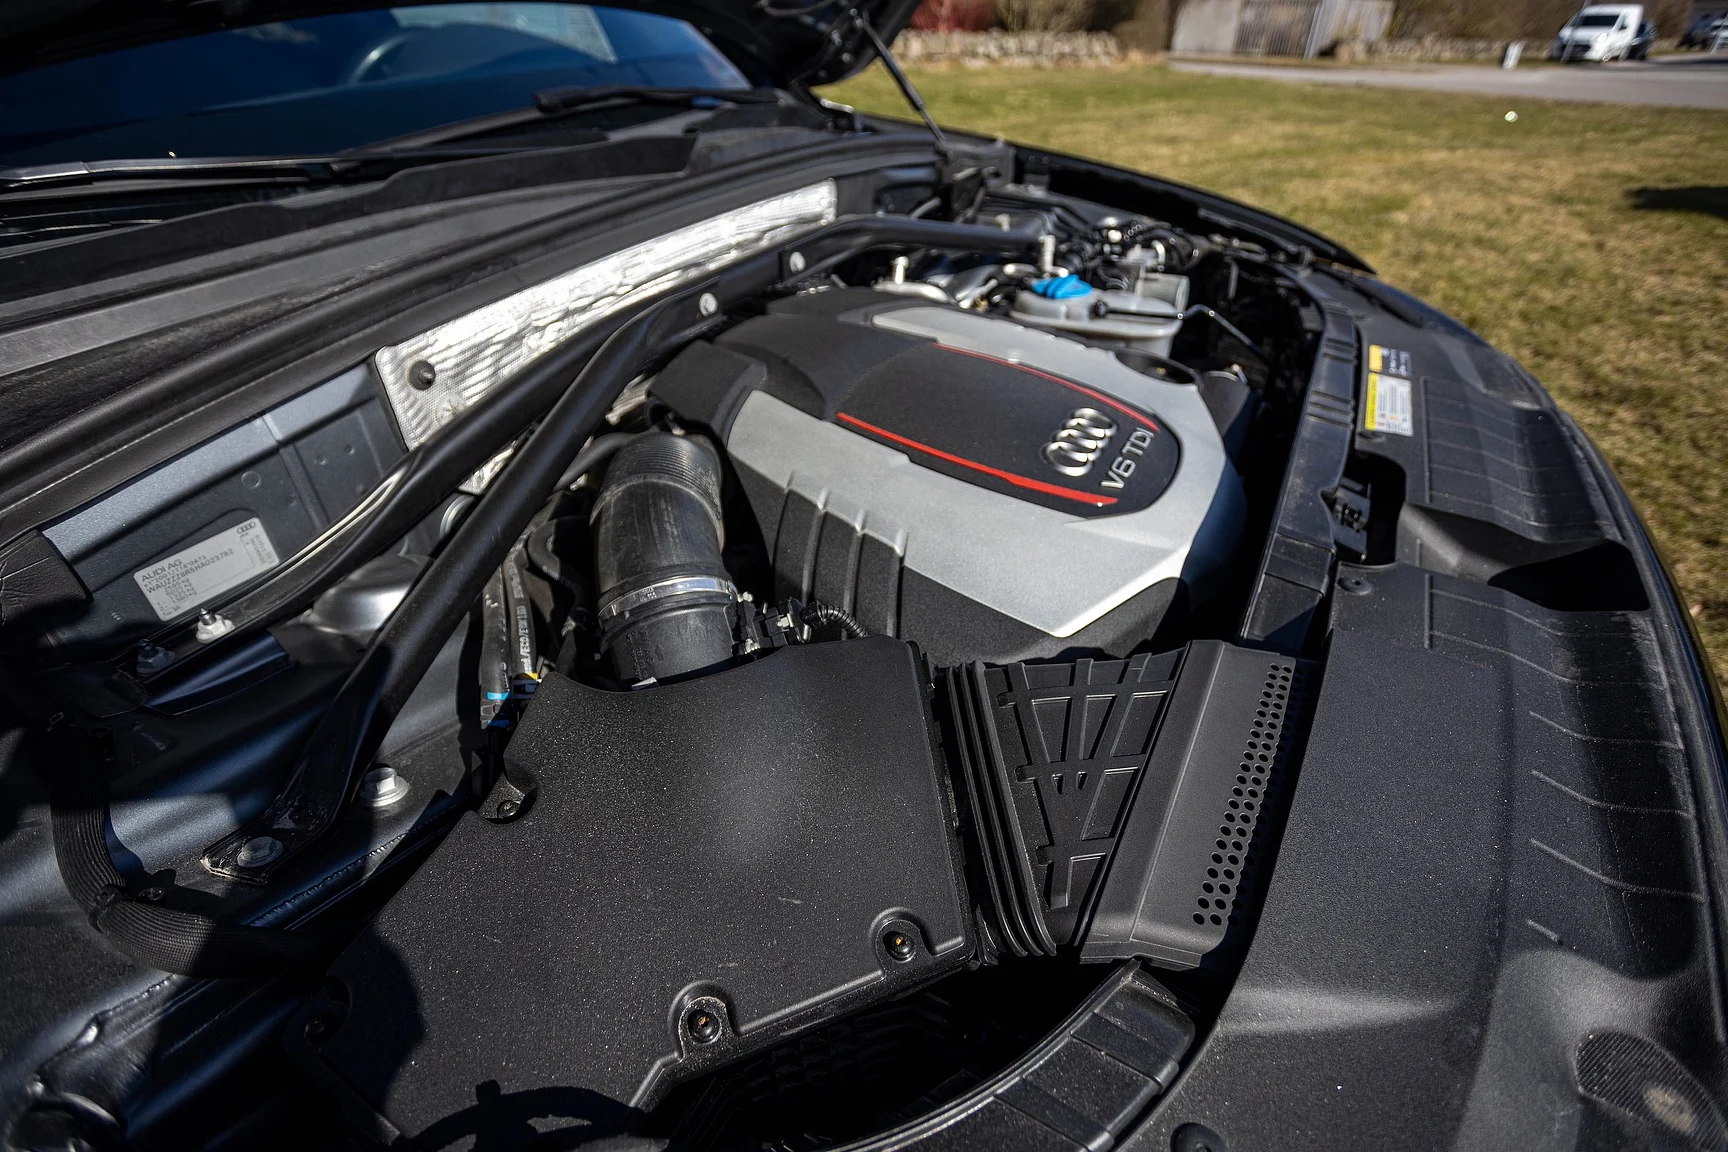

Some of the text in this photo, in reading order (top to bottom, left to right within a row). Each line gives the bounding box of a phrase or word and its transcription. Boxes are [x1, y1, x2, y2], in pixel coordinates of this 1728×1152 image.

[1100, 427, 1154, 489] V6 TDI
[141, 558, 182, 582] AUDI AG
